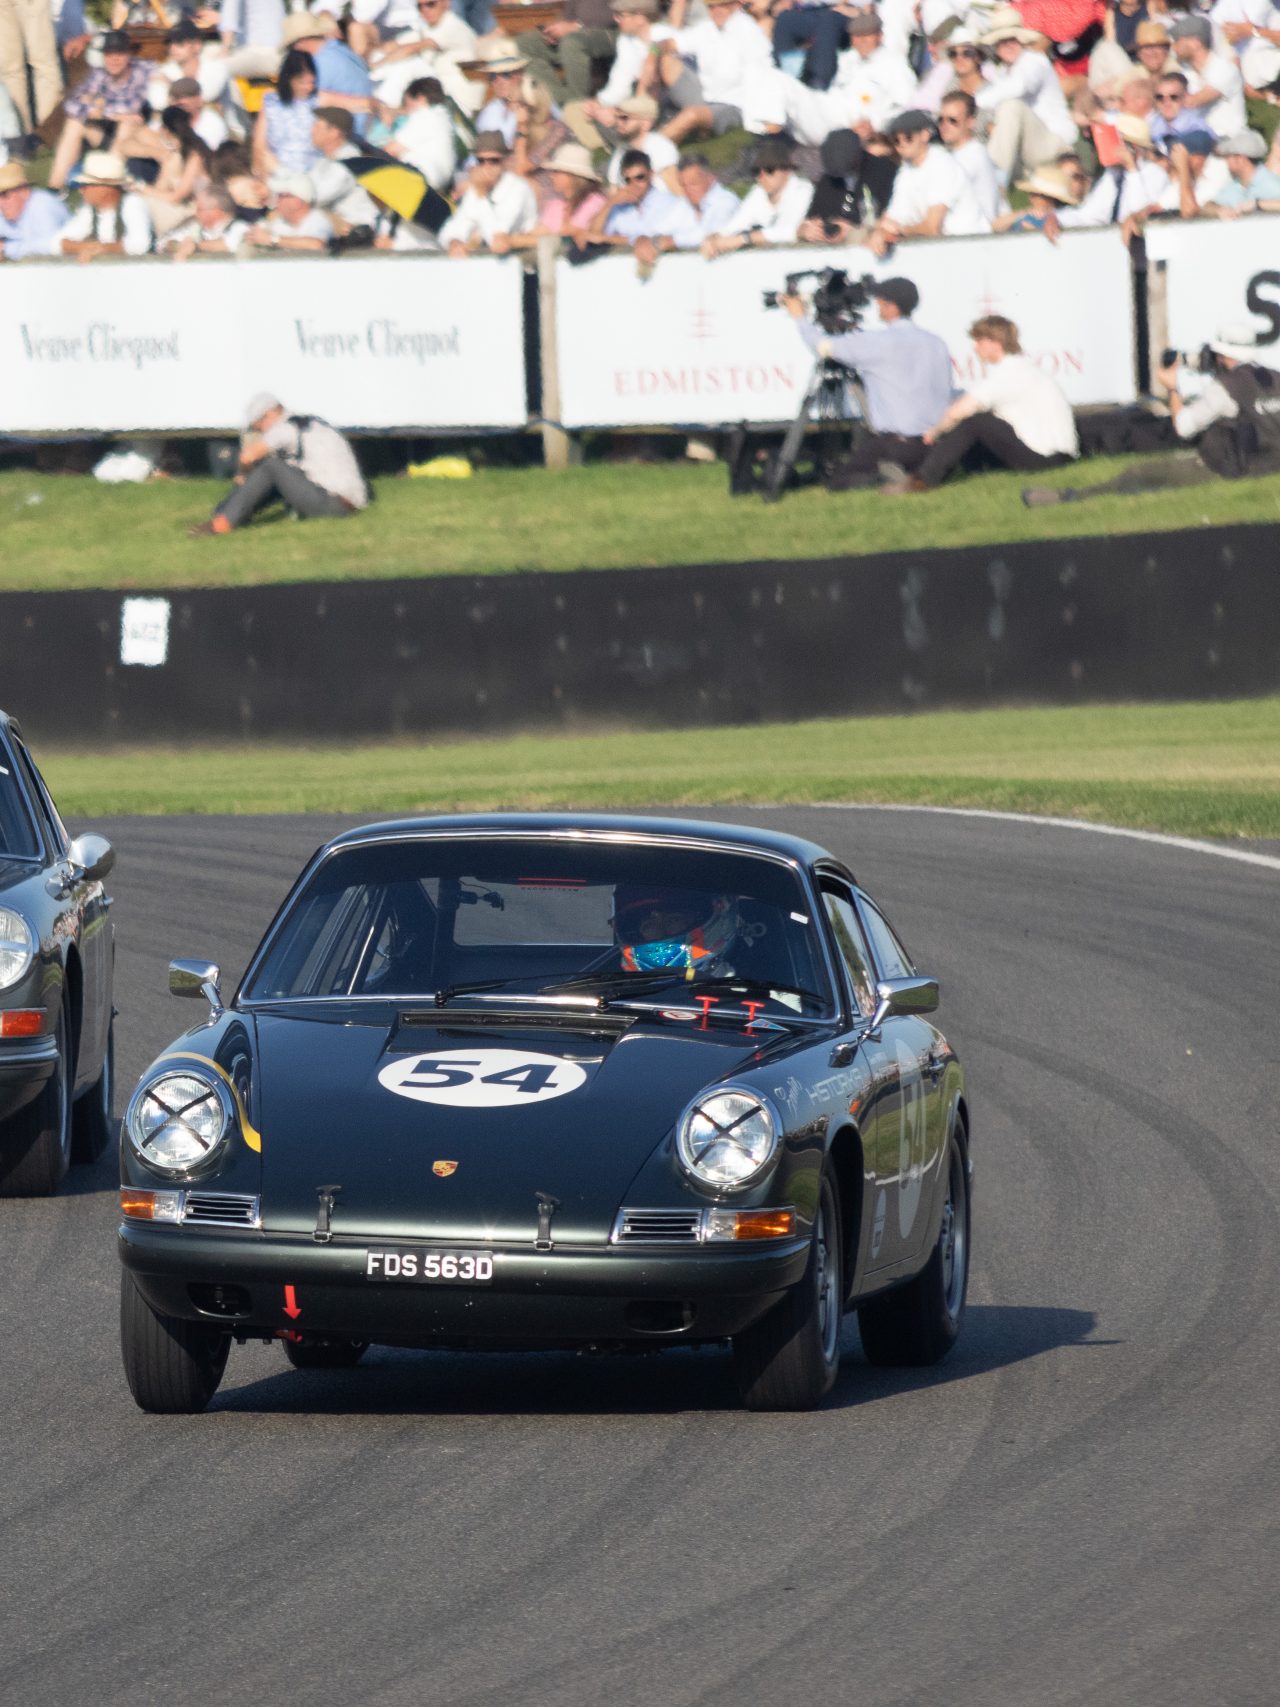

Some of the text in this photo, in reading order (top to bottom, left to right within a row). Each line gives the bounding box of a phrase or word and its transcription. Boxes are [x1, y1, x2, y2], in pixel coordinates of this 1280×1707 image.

[613, 363, 797, 397] EDMISTON
[398, 1059, 559, 1093] 54
[367, 1253, 493, 1280] FDS 563D
